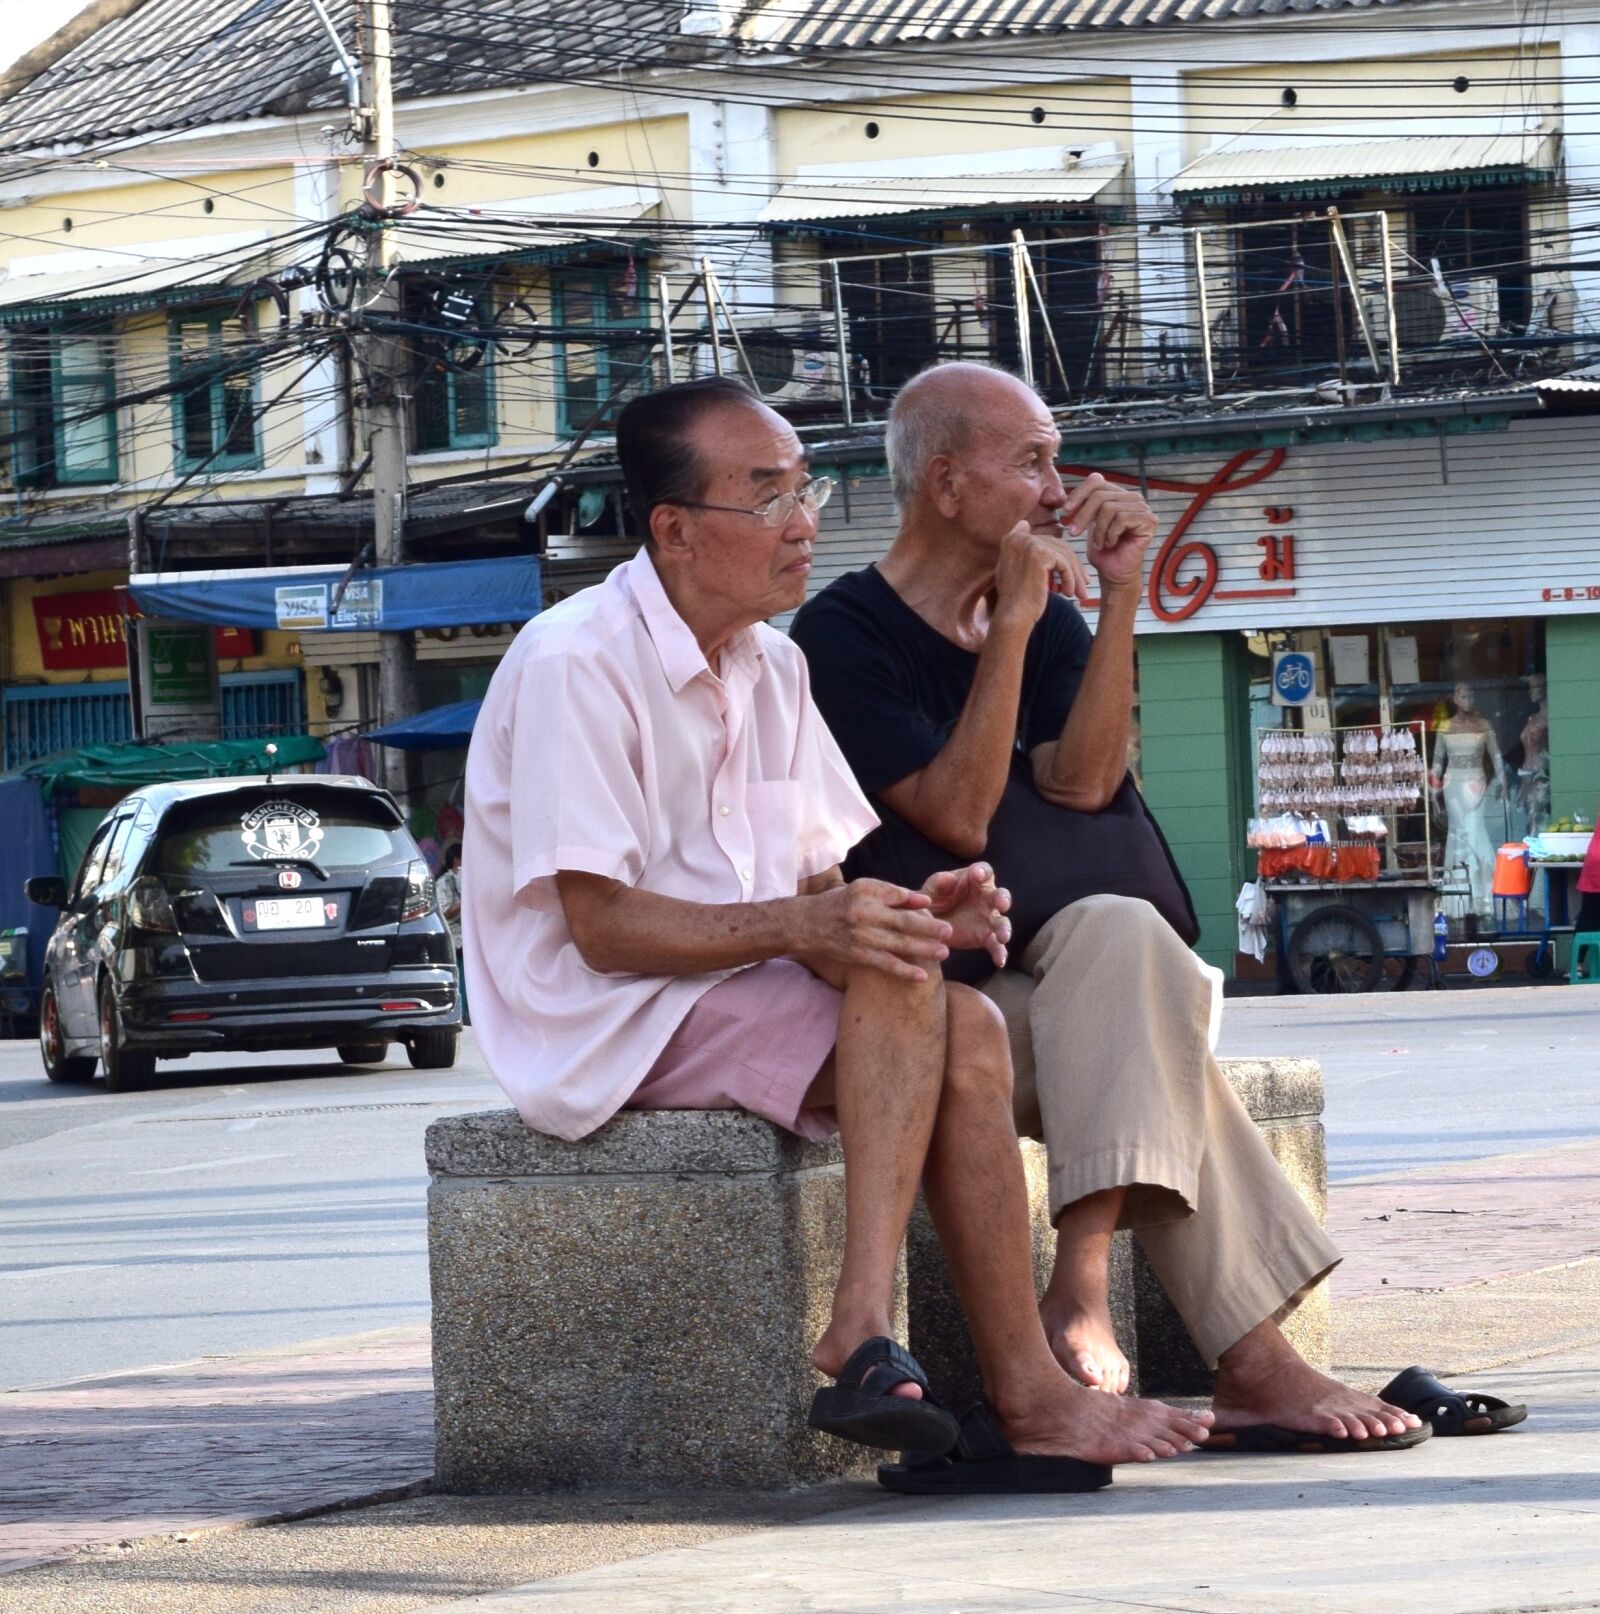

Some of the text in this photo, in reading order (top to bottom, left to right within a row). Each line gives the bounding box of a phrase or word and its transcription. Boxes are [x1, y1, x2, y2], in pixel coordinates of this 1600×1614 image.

[345, 586, 369, 600] VISA
[282, 599, 320, 616] VISA
[247, 803, 313, 827] MANCHESTER
[295, 900, 312, 914] 20
